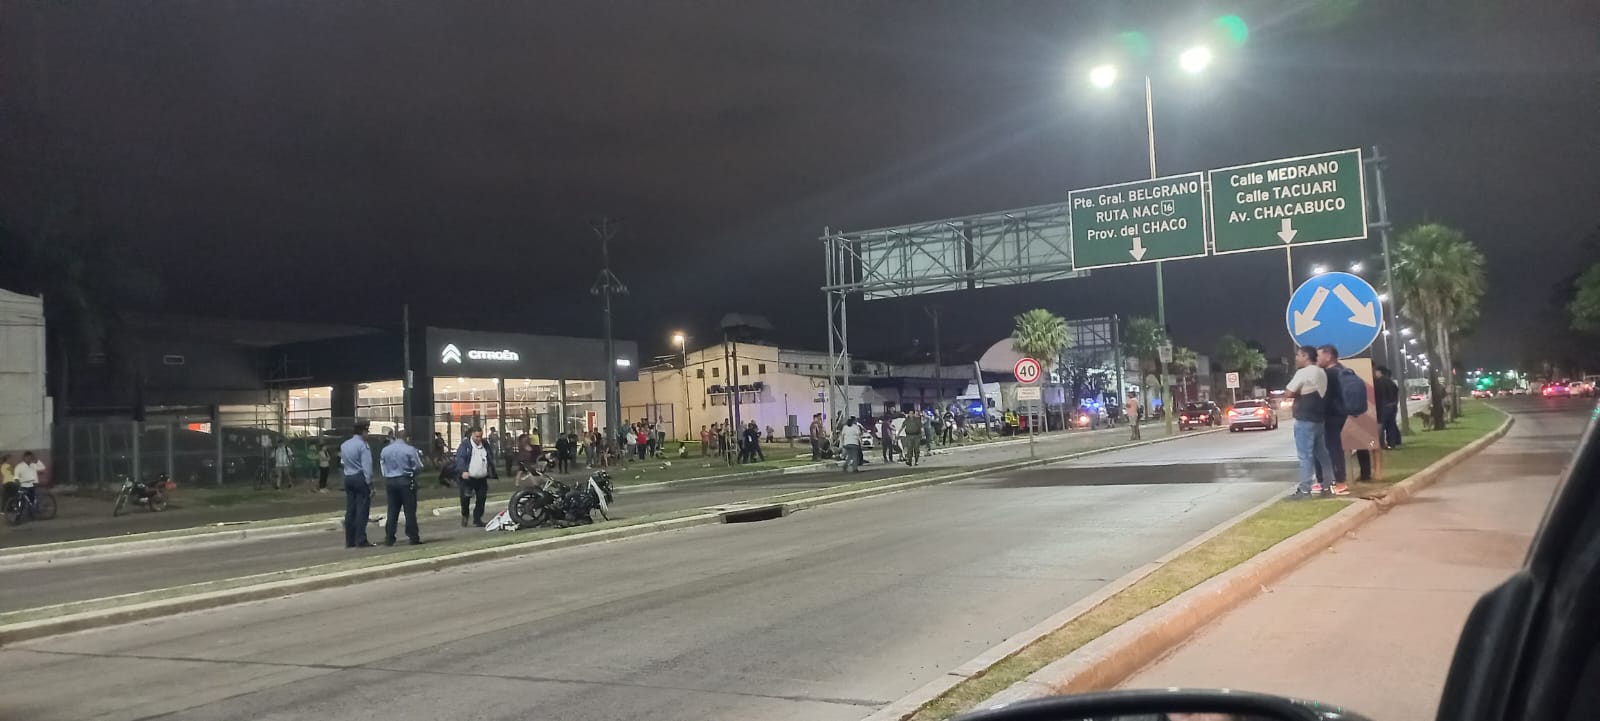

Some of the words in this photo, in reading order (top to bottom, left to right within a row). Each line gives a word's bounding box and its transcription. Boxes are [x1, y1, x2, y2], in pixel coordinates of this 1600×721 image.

[1231, 172, 1263, 187] Calle
[1267, 161, 1338, 182] MEDRANO
[1074, 197, 1095, 209] Pte.
[1098, 192, 1125, 206] Gral.
[1129, 181, 1198, 201] BELGRANO
[1236, 190, 1269, 204] Calle
[1272, 180, 1337, 199] TACUARI
[1096, 210, 1129, 223] RUTA
[1132, 205, 1159, 218] NAC
[1163, 203, 1173, 213] 16
[1229, 210, 1250, 224] Av.
[1254, 198, 1345, 220] CHACABUCO
[1087, 228, 1117, 241] Prov.
[1120, 224, 1138, 236] del
[1142, 217, 1187, 234] CHACO
[1019, 365, 1036, 377] 40
